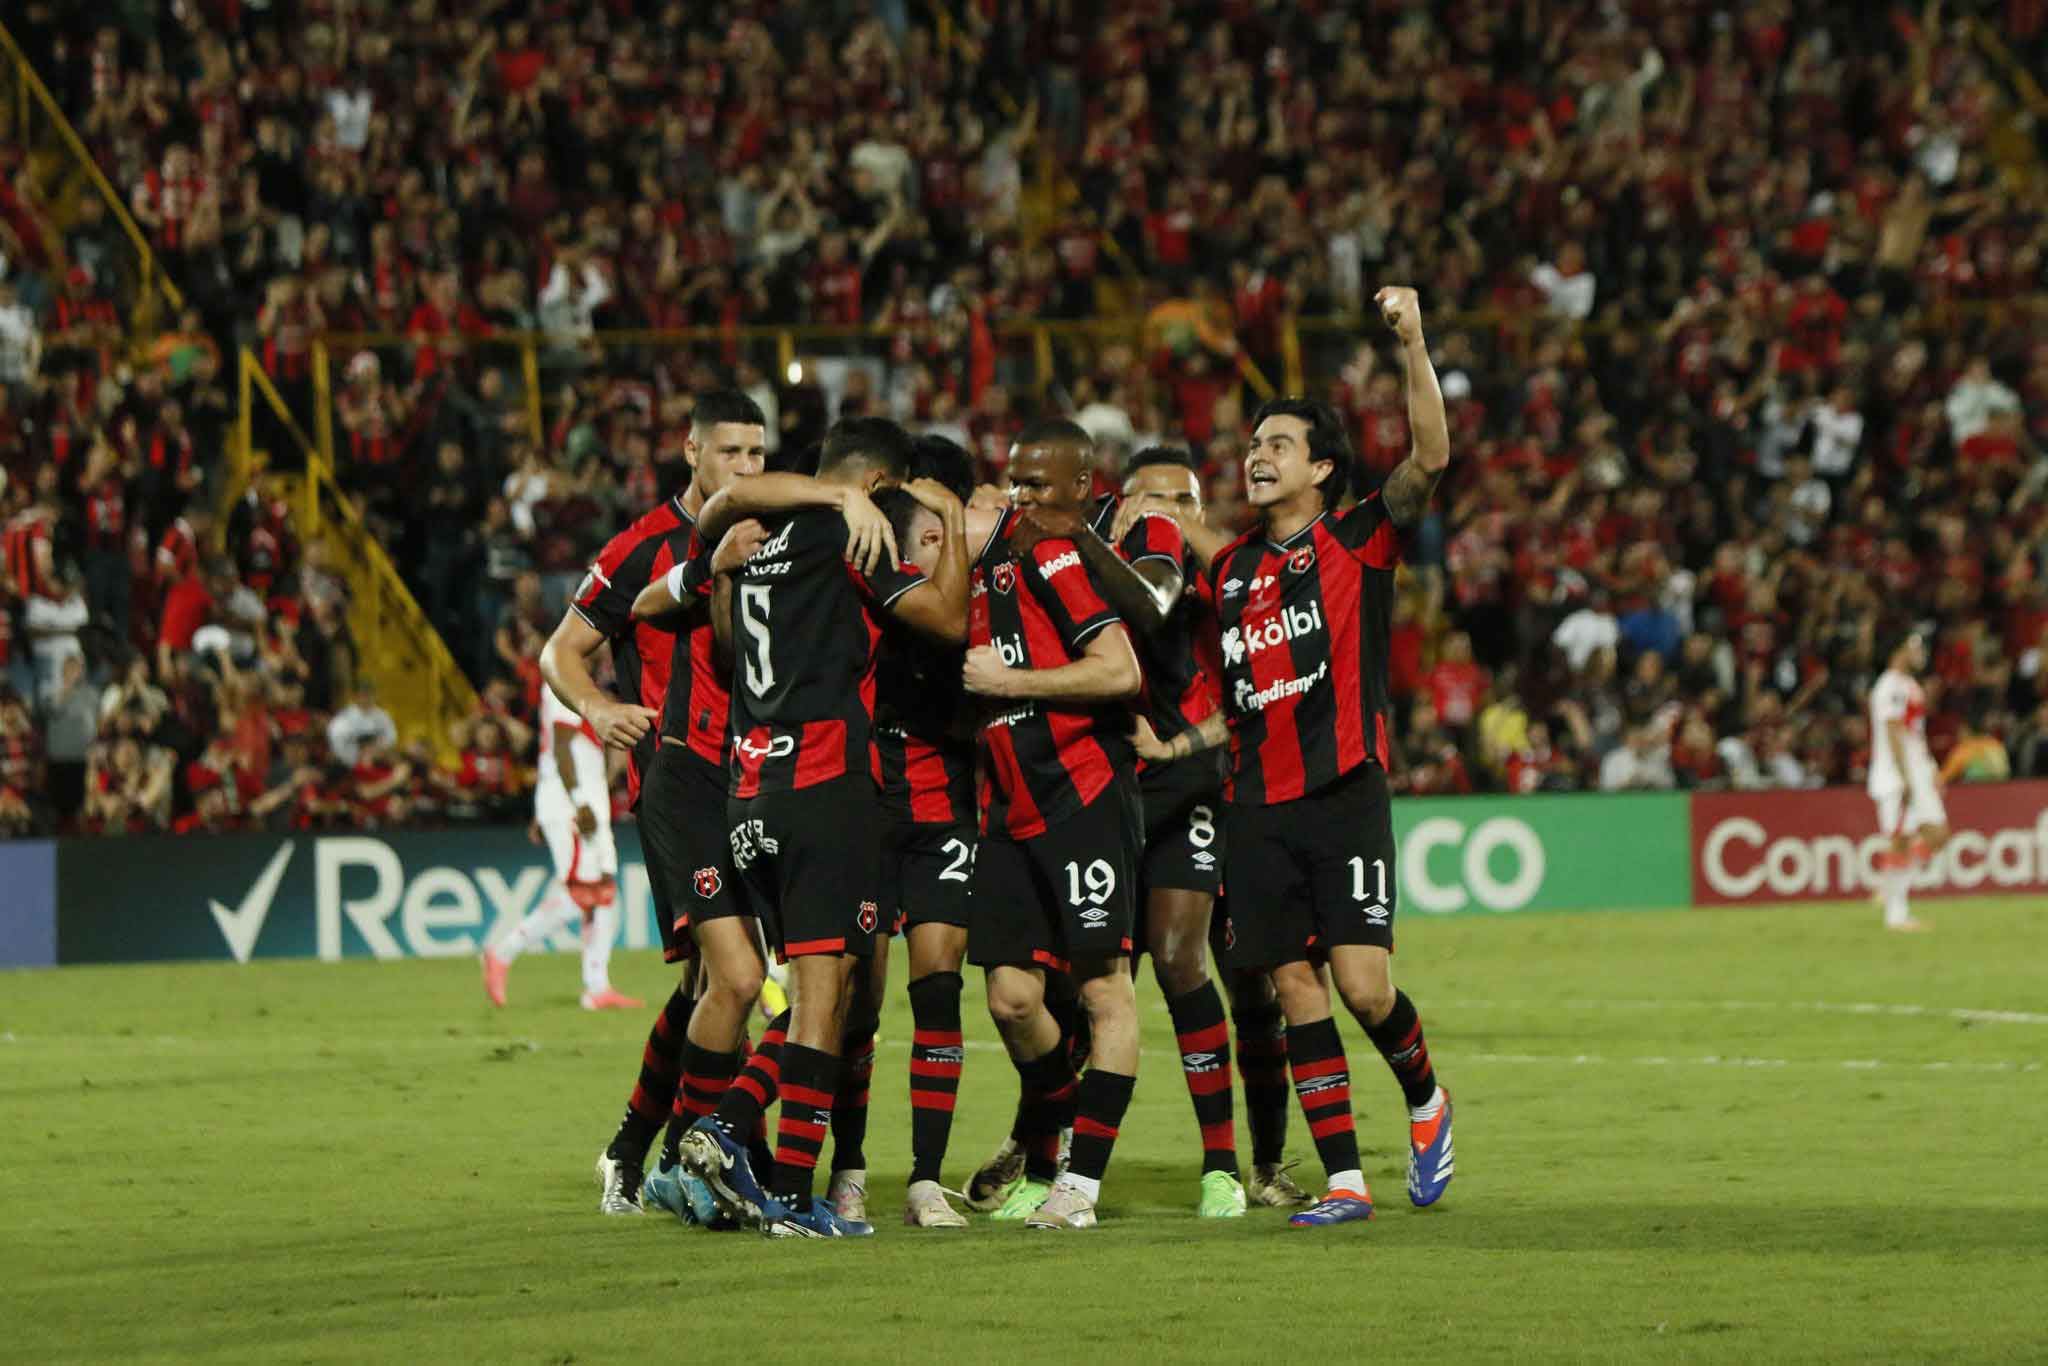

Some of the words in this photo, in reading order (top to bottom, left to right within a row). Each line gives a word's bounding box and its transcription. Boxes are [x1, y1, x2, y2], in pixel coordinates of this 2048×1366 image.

[740, 583, 776, 699] 5
[1245, 600, 1321, 654] kölbi
[1189, 805, 1215, 847] 8
[939, 838, 978, 882] 2
[1064, 859, 1115, 905] 19
[1347, 856, 1390, 904] 11
